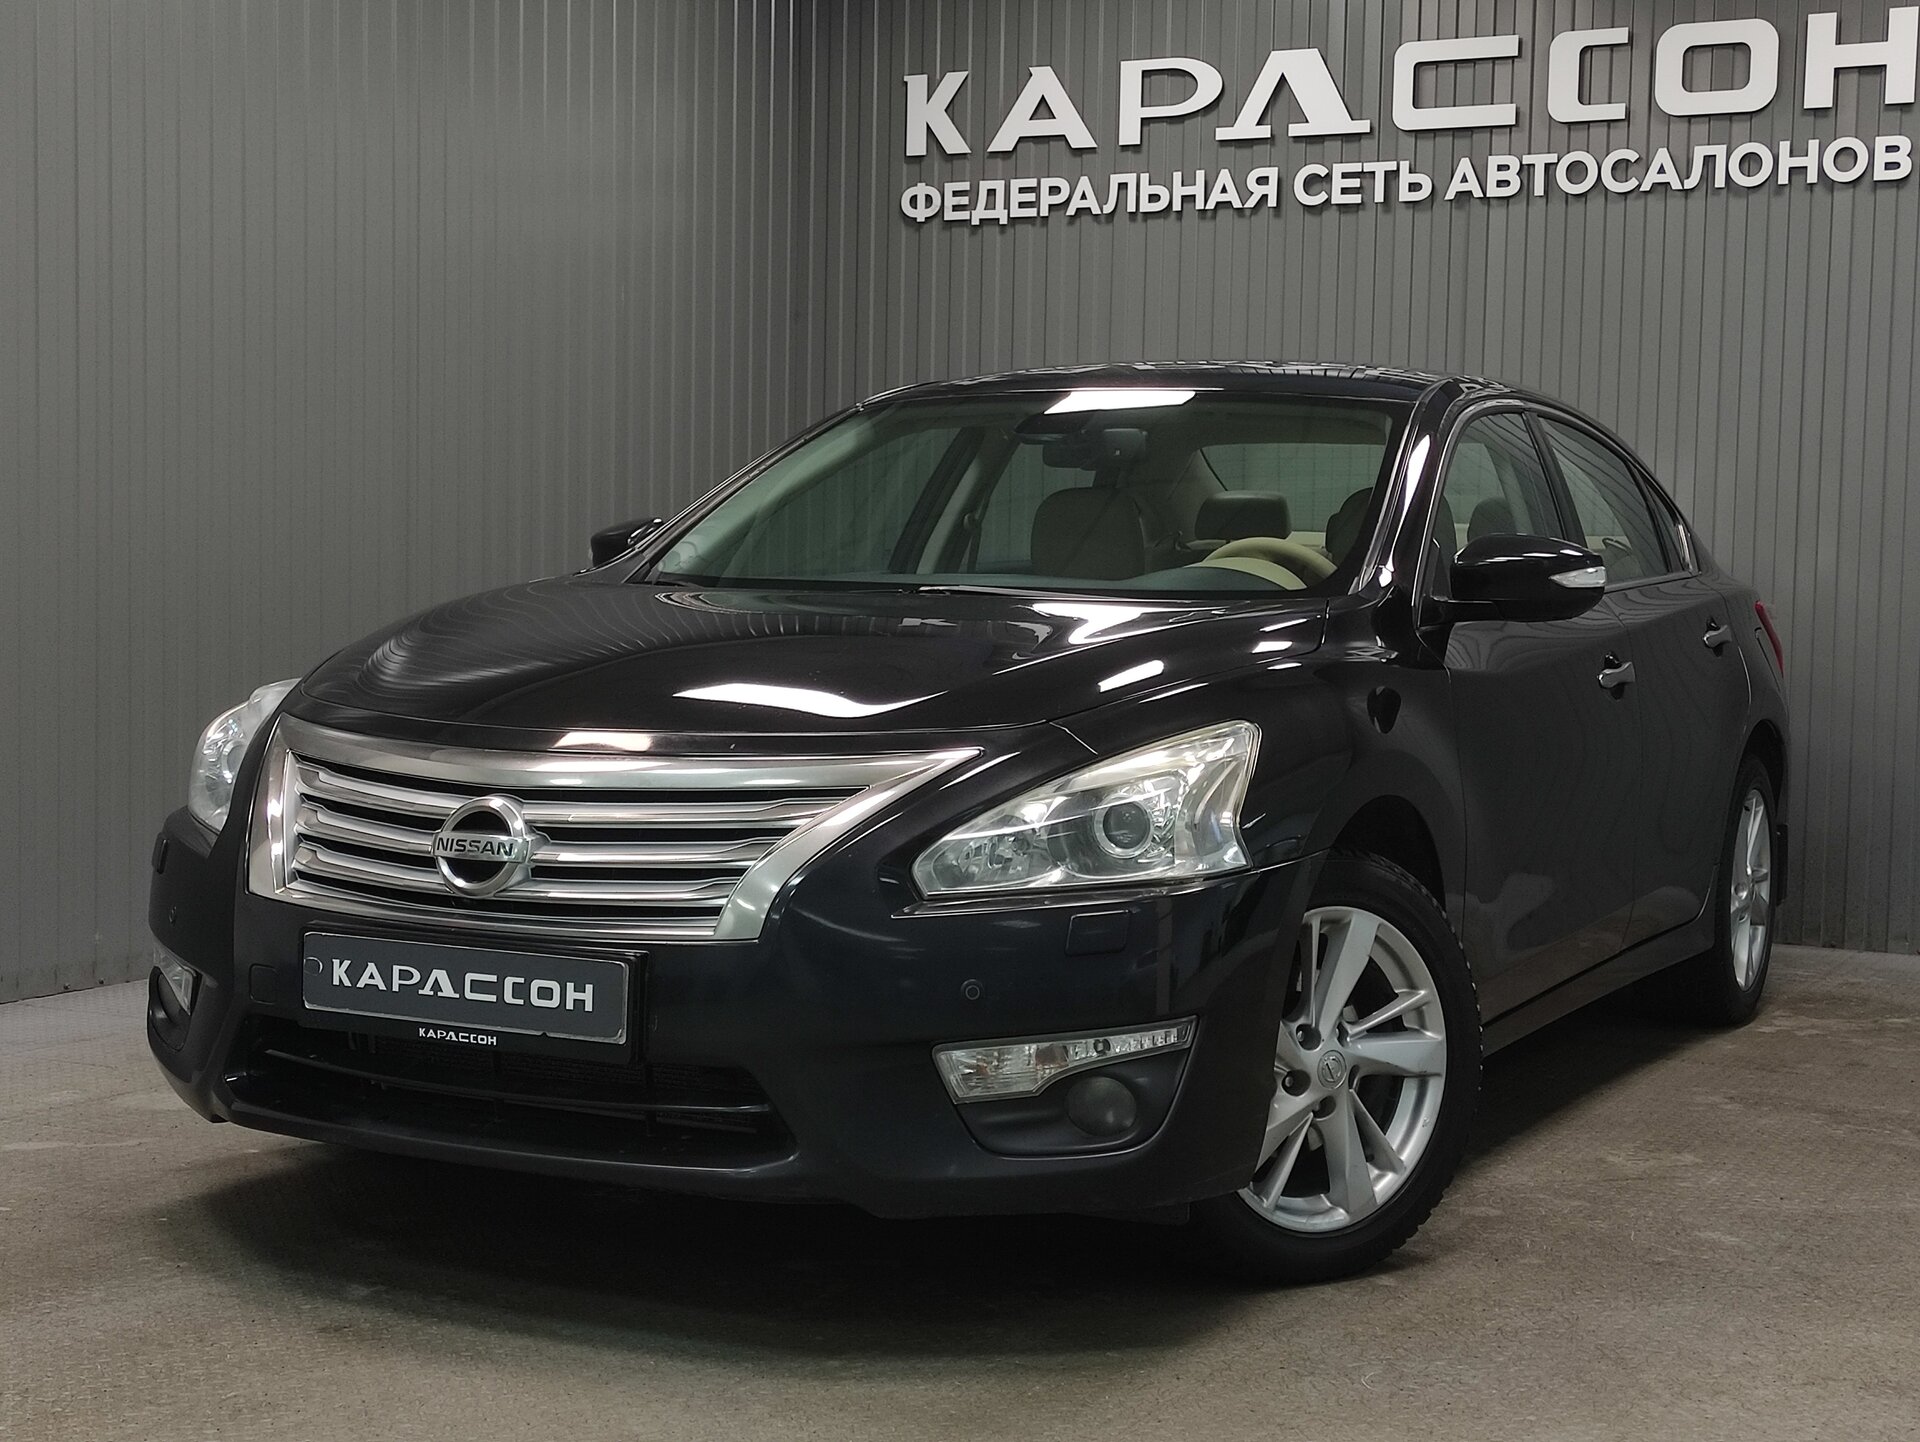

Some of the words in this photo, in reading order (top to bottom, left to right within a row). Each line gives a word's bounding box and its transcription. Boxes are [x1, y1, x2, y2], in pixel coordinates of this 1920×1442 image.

[900, 166, 1280, 226] ФЕДЕРАЛЬНАЯ
[1293, 160, 1433, 206] СЕТЬ
[1444, 135, 1913, 200] АВТОСАЛОНОВ
[436, 837, 514, 857] NISSAN
